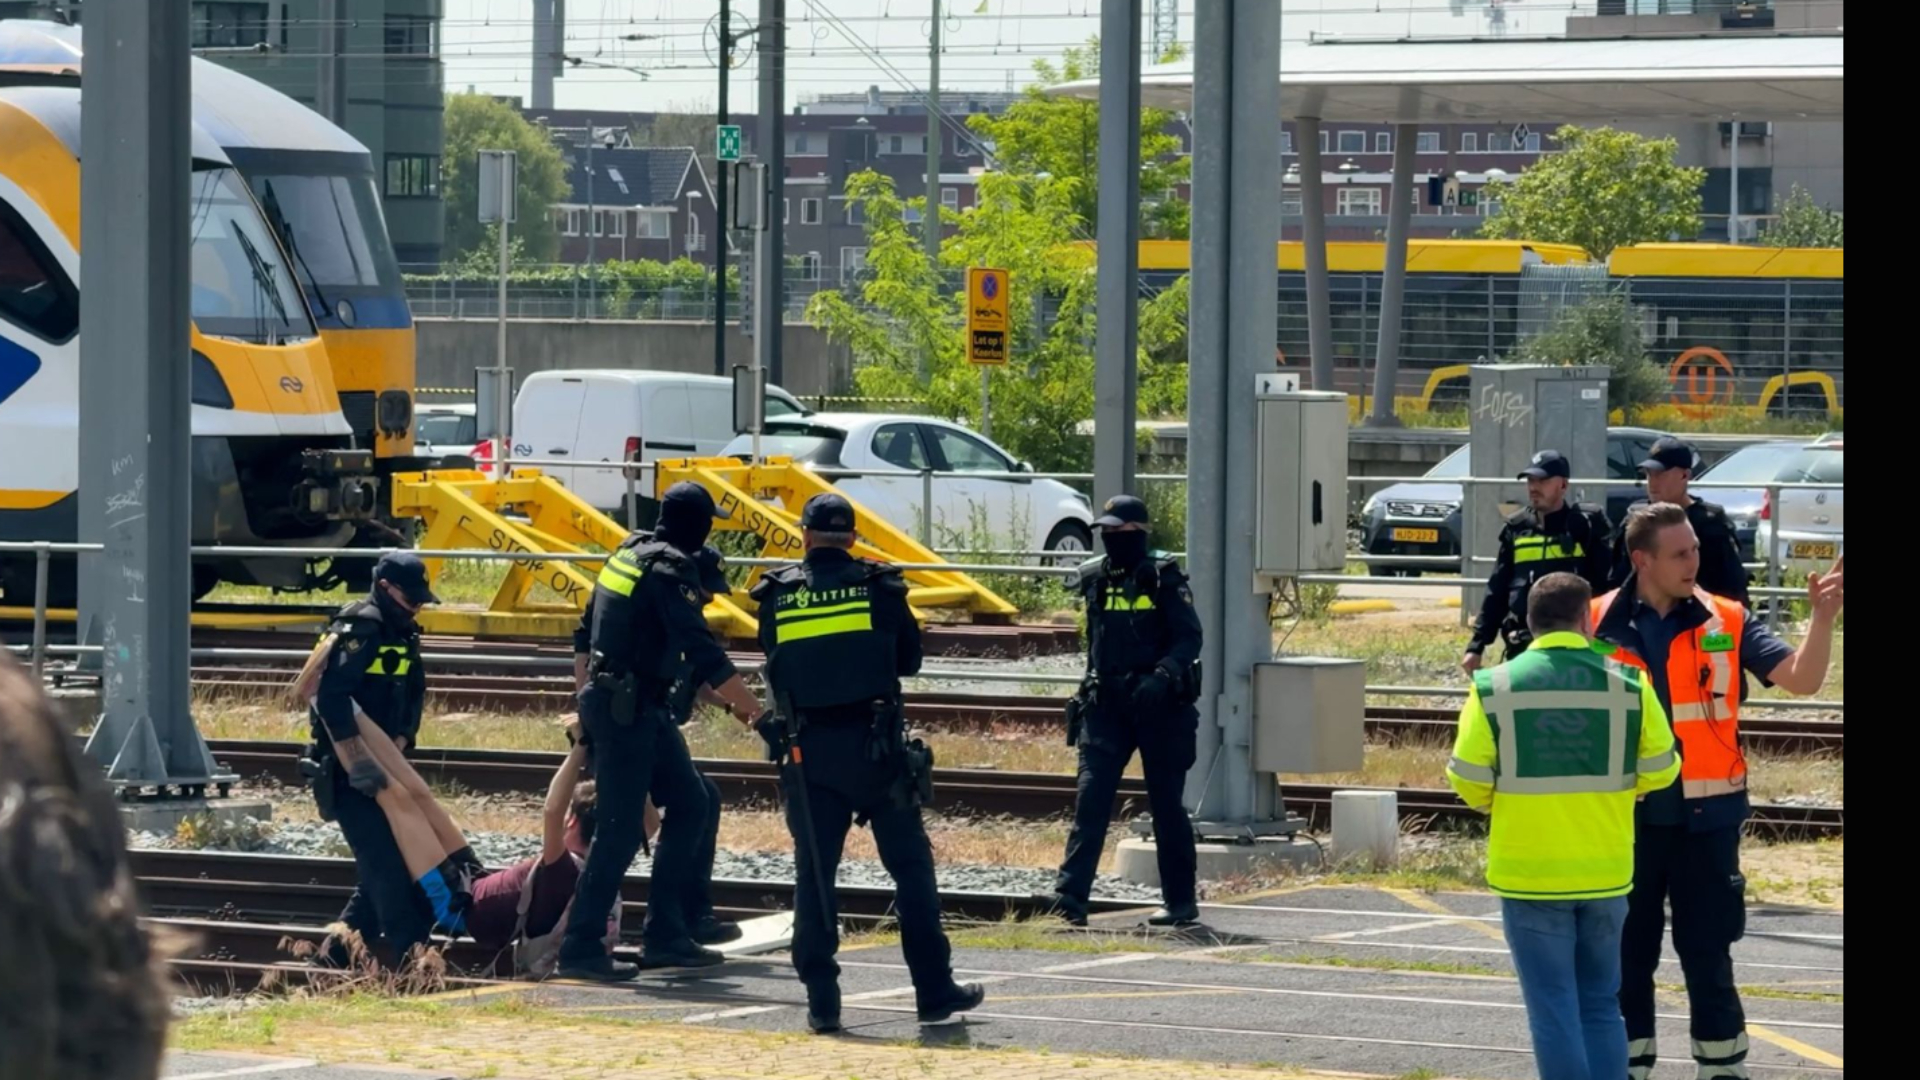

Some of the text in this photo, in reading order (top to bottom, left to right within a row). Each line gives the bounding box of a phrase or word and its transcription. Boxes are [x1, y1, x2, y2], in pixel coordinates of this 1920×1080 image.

[1446, 187, 1456, 204] A
[550, 571, 586, 606] OK
[785, 585, 858, 608] POLITIE
